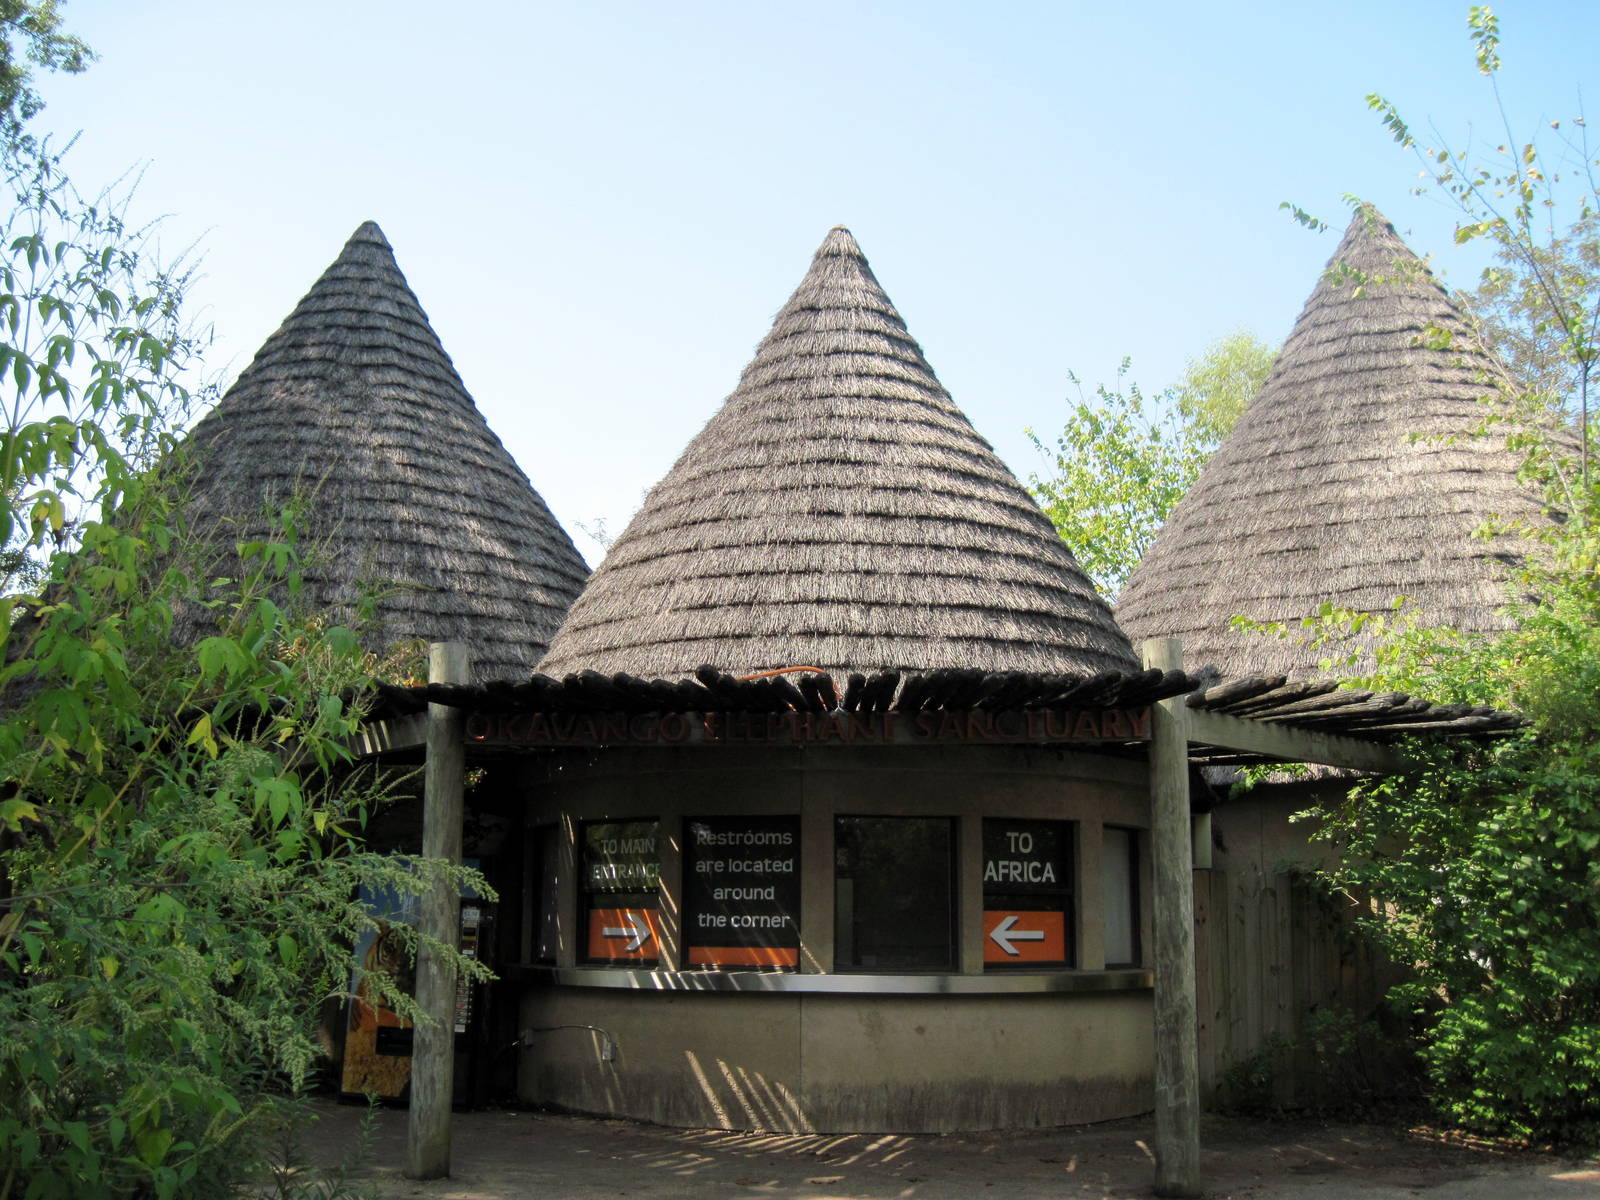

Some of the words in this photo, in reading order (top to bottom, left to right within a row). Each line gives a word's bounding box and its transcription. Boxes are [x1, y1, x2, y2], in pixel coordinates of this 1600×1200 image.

[466, 711, 689, 742] OKAVANGO
[704, 709, 899, 741] ELEPHANT
[915, 706, 1152, 741] SANCTUARY
[696, 829, 793, 846] Restrooms
[1006, 831, 1033, 854] TO
[601, 838, 617, 855] TO
[620, 838, 656, 855] MAIN
[695, 861, 724, 873] are
[728, 858, 793, 873] located
[983, 860, 1056, 883] AFRICA
[713, 886, 775, 901] around
[697, 912, 727, 927] the
[730, 914, 790, 928] corner
